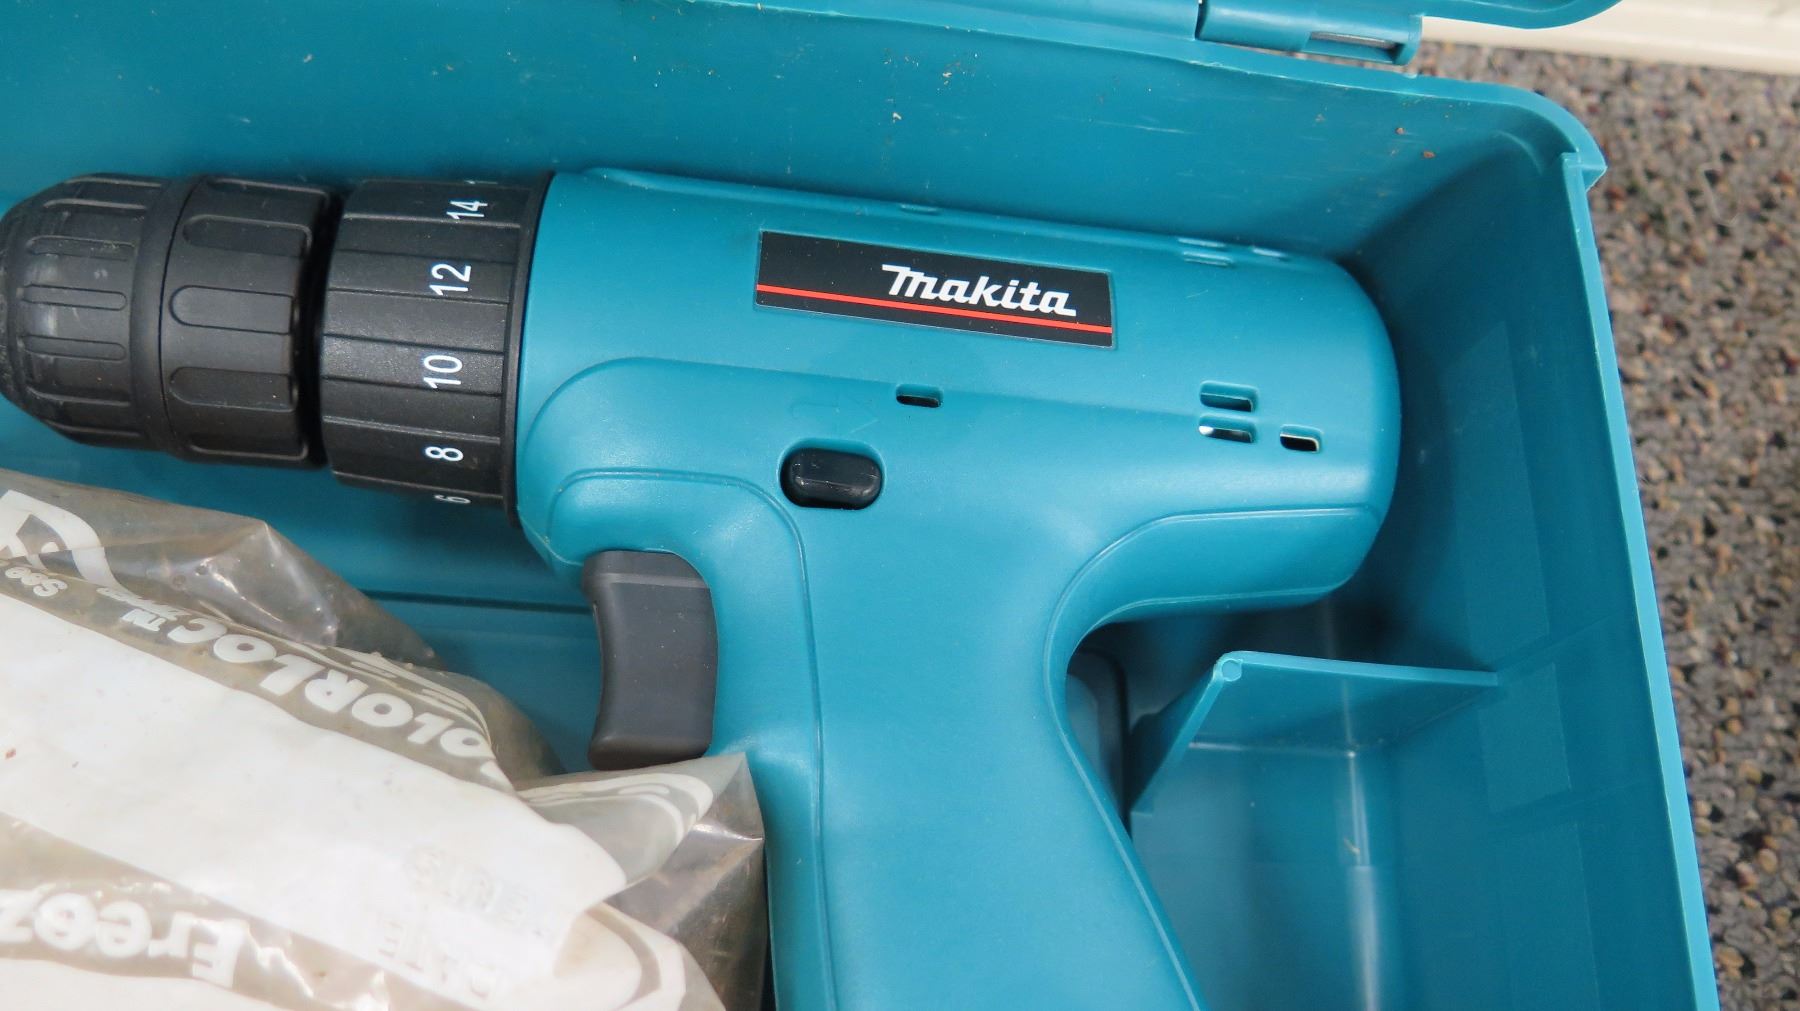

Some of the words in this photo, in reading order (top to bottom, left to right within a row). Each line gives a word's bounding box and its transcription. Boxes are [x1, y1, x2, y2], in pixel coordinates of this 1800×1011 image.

[446, 200, 488, 220] 14
[429, 263, 472, 296] 12
[423, 354, 463, 389] 10
[424, 446, 464, 462] 8
[4, 566, 68, 597] See
